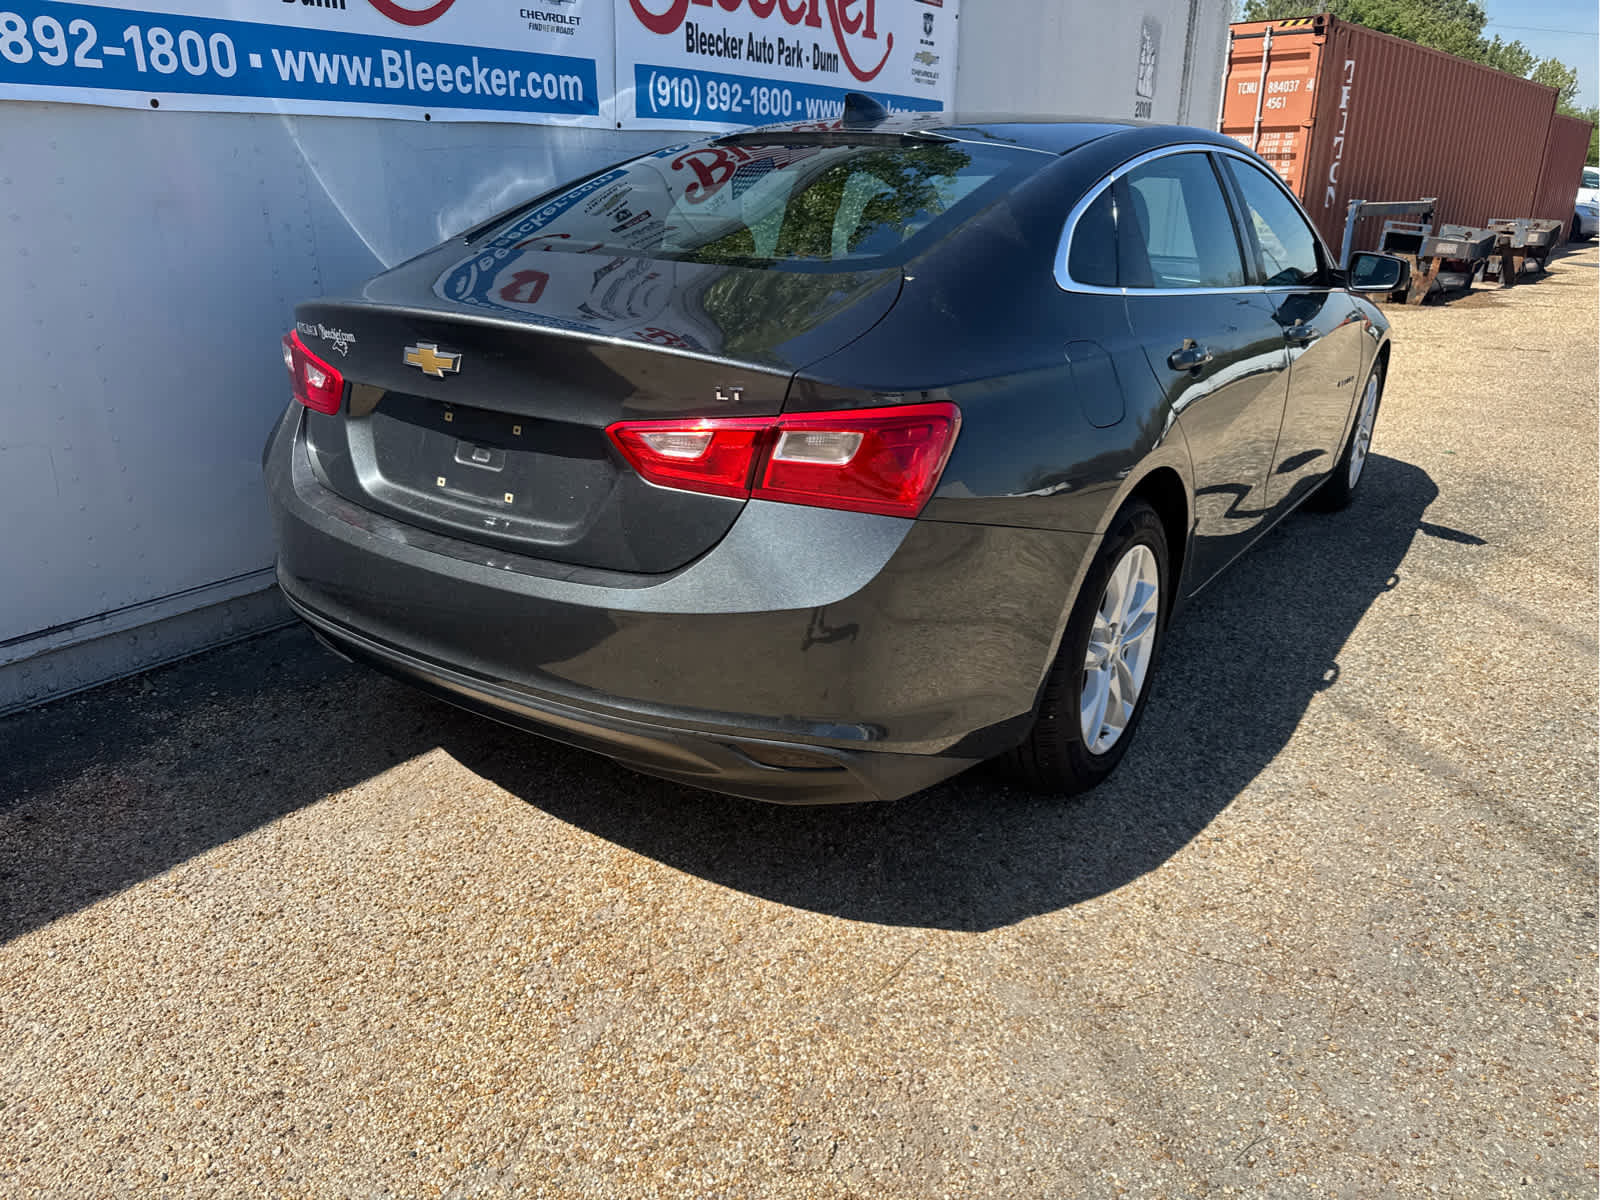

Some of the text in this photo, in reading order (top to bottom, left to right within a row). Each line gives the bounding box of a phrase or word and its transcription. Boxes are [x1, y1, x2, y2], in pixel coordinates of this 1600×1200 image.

[519, 9, 581, 26] CHEVROLET
[0, 12, 583, 101] 892-1800 www.Bleecker.com
[685, 21, 839, 73] Bleecker Auto Park Dunn
[649, 71, 700, 115] (910)
[706, 81, 792, 116] 892-1800
[713, 386, 744, 401] LT
